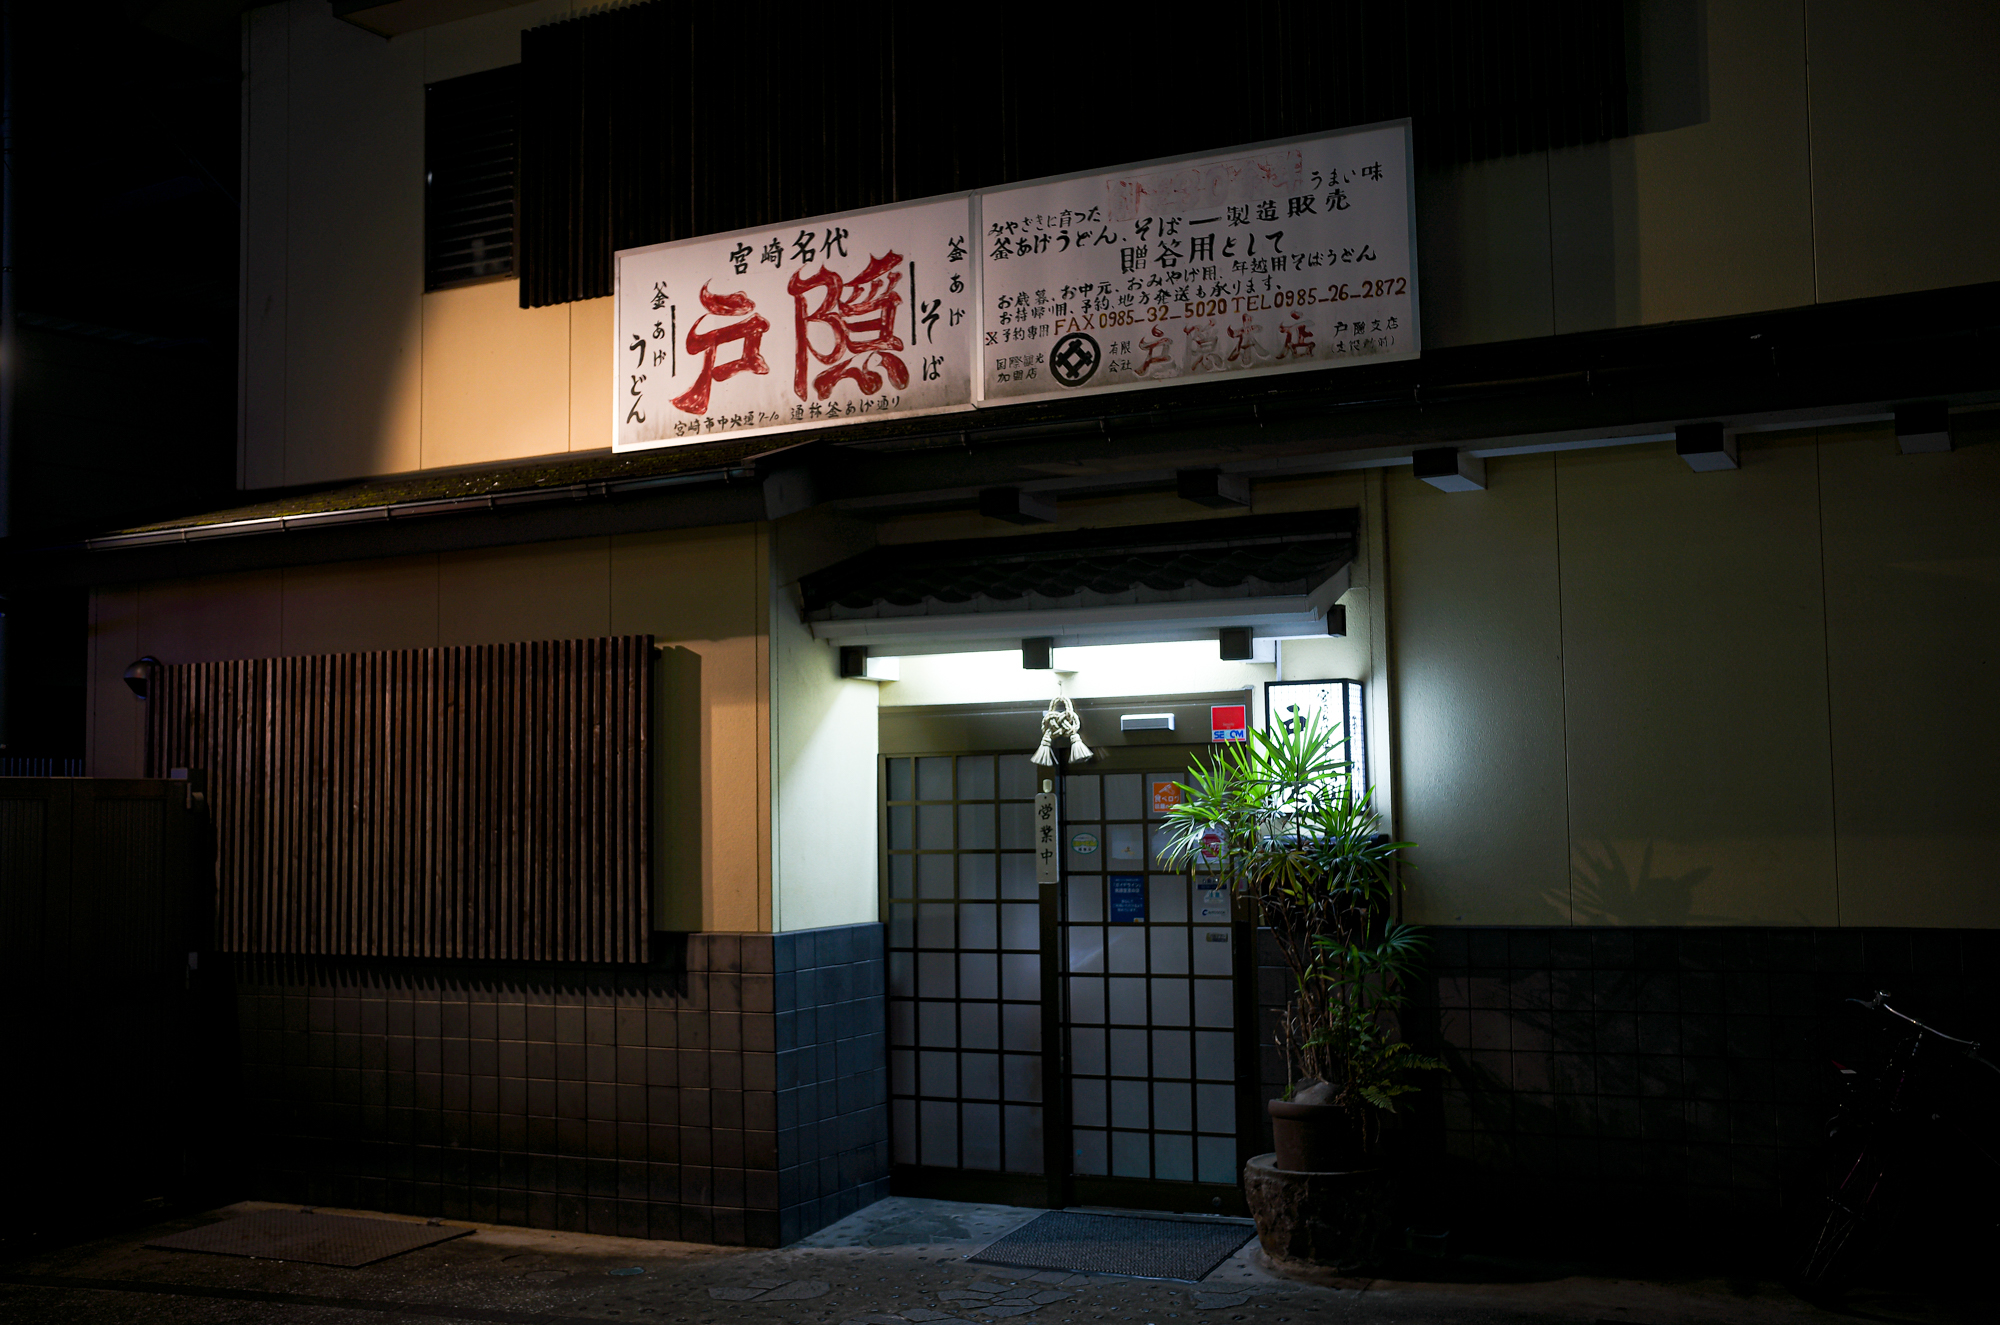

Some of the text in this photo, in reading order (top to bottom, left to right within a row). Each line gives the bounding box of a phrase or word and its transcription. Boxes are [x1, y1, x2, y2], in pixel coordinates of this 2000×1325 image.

[1309, 161, 1384, 191] うまい味
[987, 204, 1101, 237] みやざきに育った
[730, 227, 850, 276] 宮崎名代
[947, 235, 969, 328] 釜あげ
[1119, 230, 1285, 274] 贈答用として
[650, 280, 669, 368] 釜あげ
[669, 248, 911, 415] 戸隠
[1054, 312, 1096, 336] FAX
[1098, 298, 1228, 329] 0985-32-5020
[1232, 293, 1272, 314] TEL
[1273, 276, 1408, 310] 0985-26-2872
[920, 298, 945, 382] そば
[626, 333, 647, 425] うどん
[997, 367, 1038, 383] 加盟店
[1038, 803, 1053, 865] 営業中
